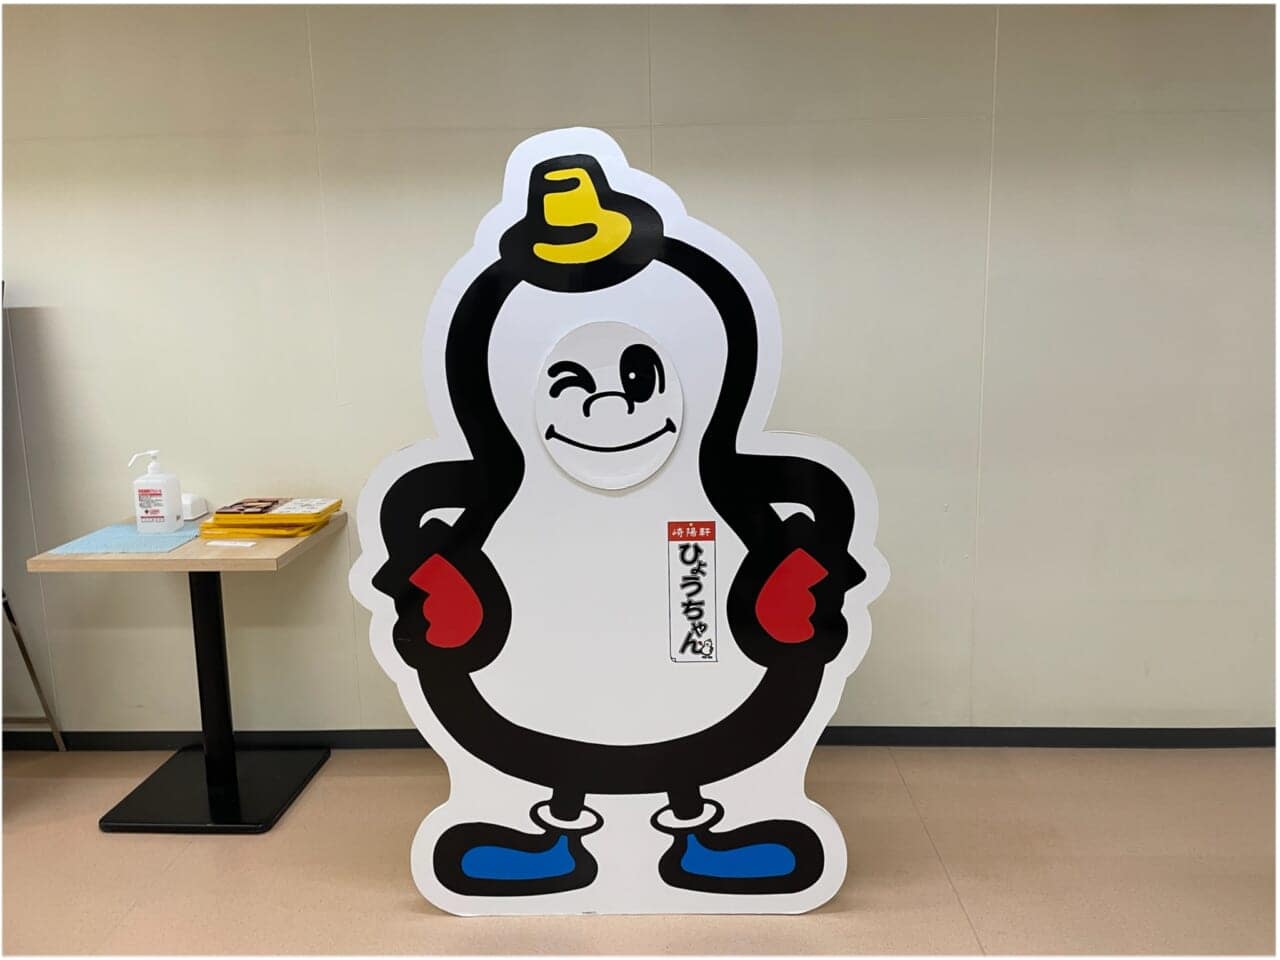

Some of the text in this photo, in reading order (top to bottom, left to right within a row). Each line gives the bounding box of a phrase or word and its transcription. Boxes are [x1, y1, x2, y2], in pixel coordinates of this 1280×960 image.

[671, 527, 712, 538] 崎陽軒
[677, 542, 708, 655] ひょうちゃん
